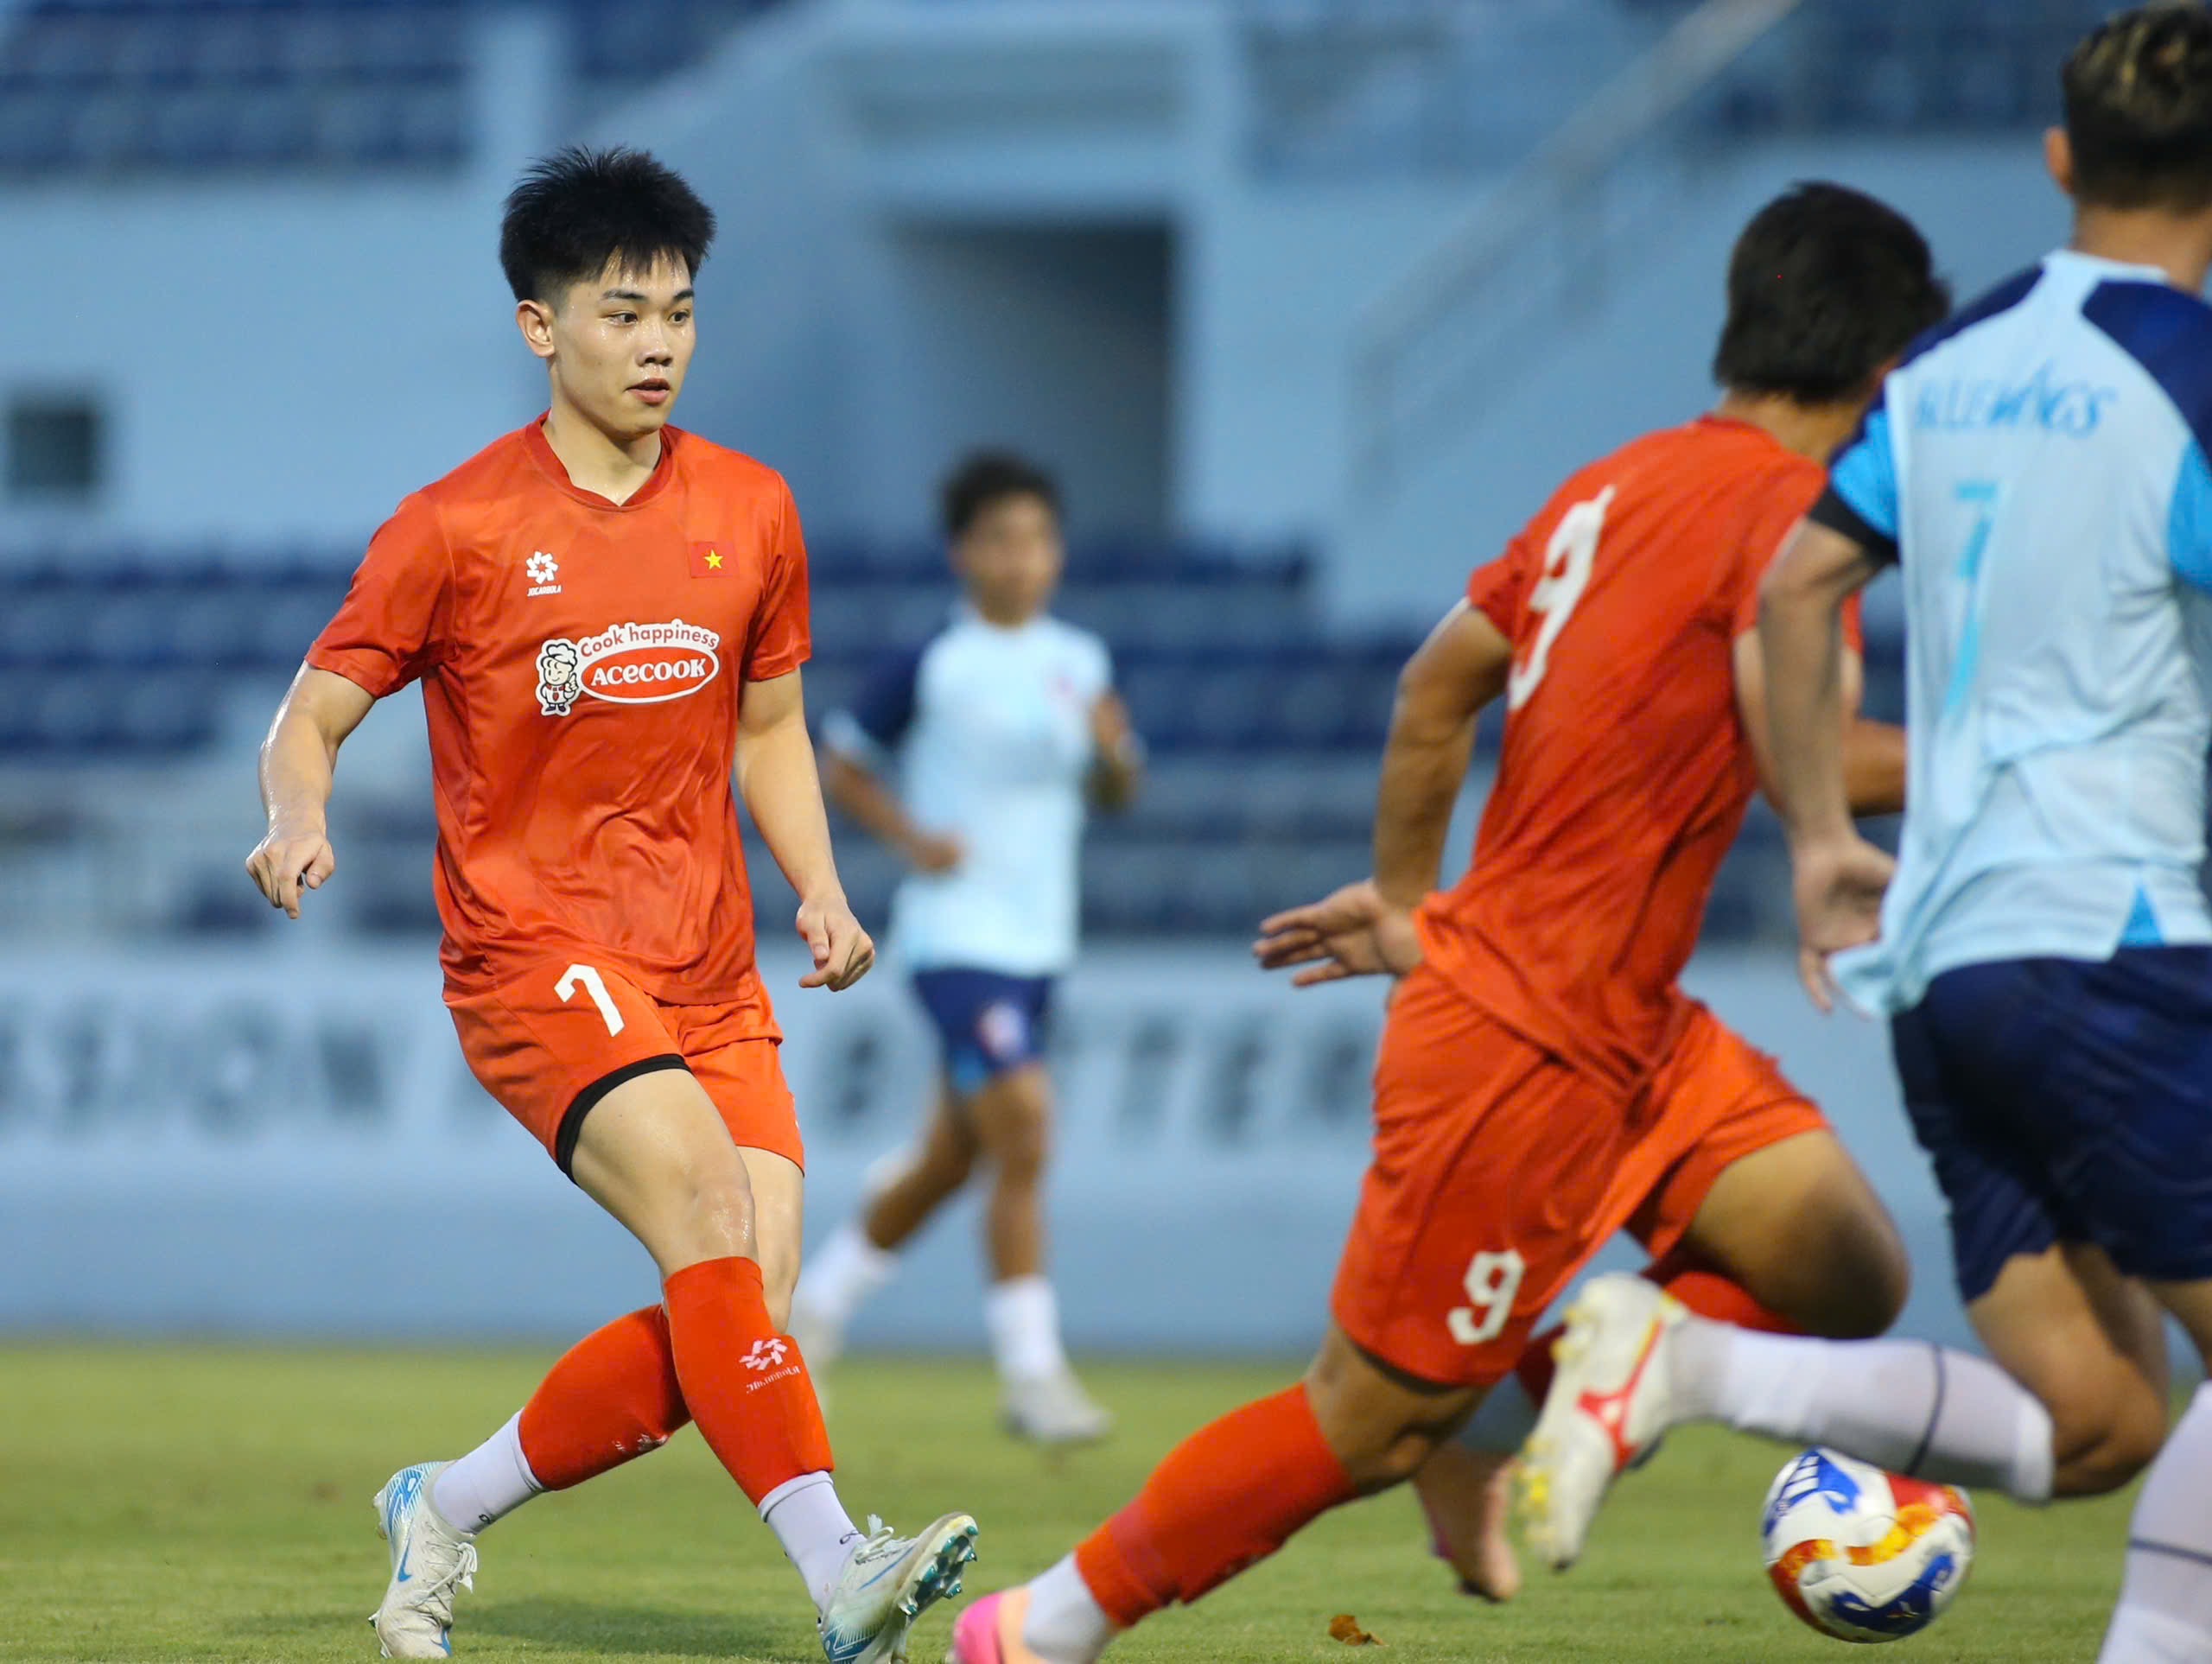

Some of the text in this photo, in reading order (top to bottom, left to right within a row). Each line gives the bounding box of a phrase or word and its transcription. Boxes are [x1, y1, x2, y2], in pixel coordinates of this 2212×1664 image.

[580, 624, 718, 658] Cook happiness
[1508, 483, 1618, 712] 9
[1950, 481, 1999, 722] 7
[554, 962, 625, 1038] 7
[1446, 1249, 1525, 1344] 9
